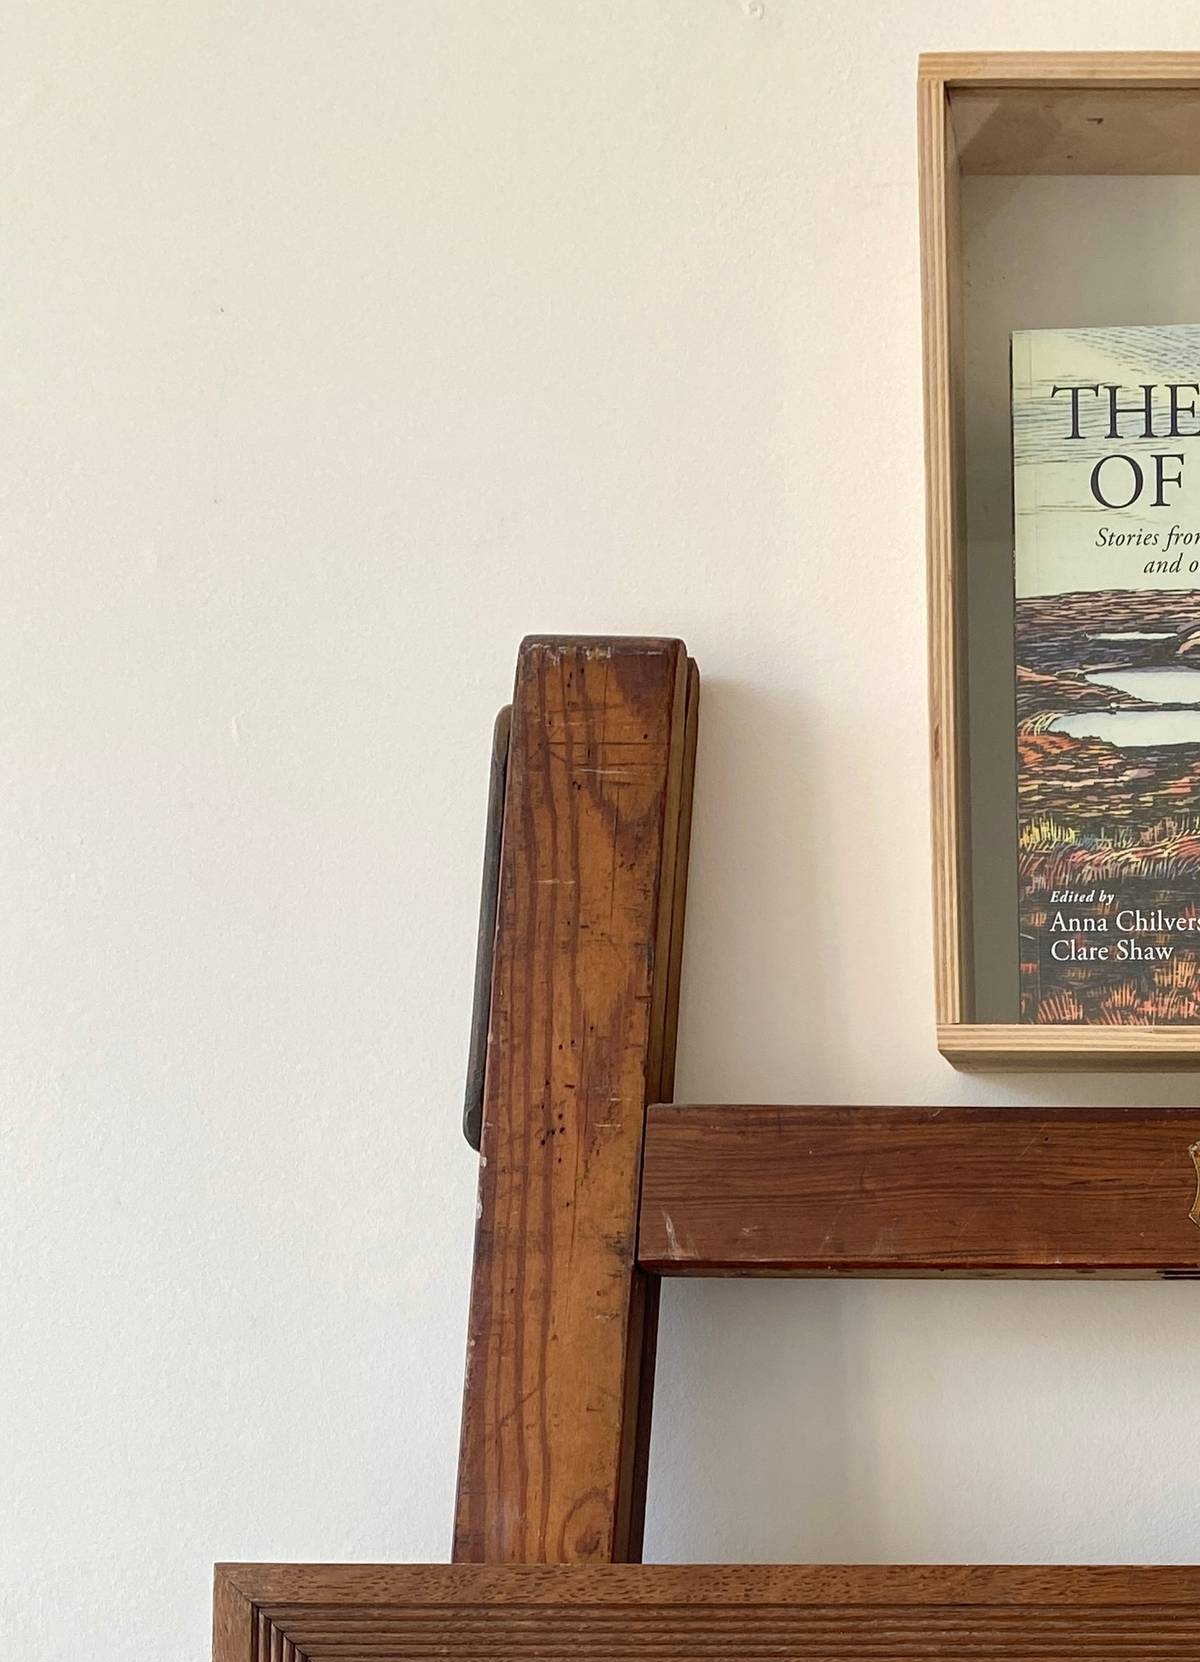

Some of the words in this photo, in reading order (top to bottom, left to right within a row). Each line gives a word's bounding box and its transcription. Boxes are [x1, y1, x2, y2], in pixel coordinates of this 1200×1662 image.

[1090, 452, 1185, 509] OF
[1095, 525, 1159, 548] Stories
[1143, 553, 1182, 574] and
[1050, 890, 1096, 903] Edited
[1098, 890, 1115, 905] by
[1050, 911, 1108, 932] Anna
[1051, 939, 1110, 961] Clare
[1116, 938, 1174, 961] Shaw
